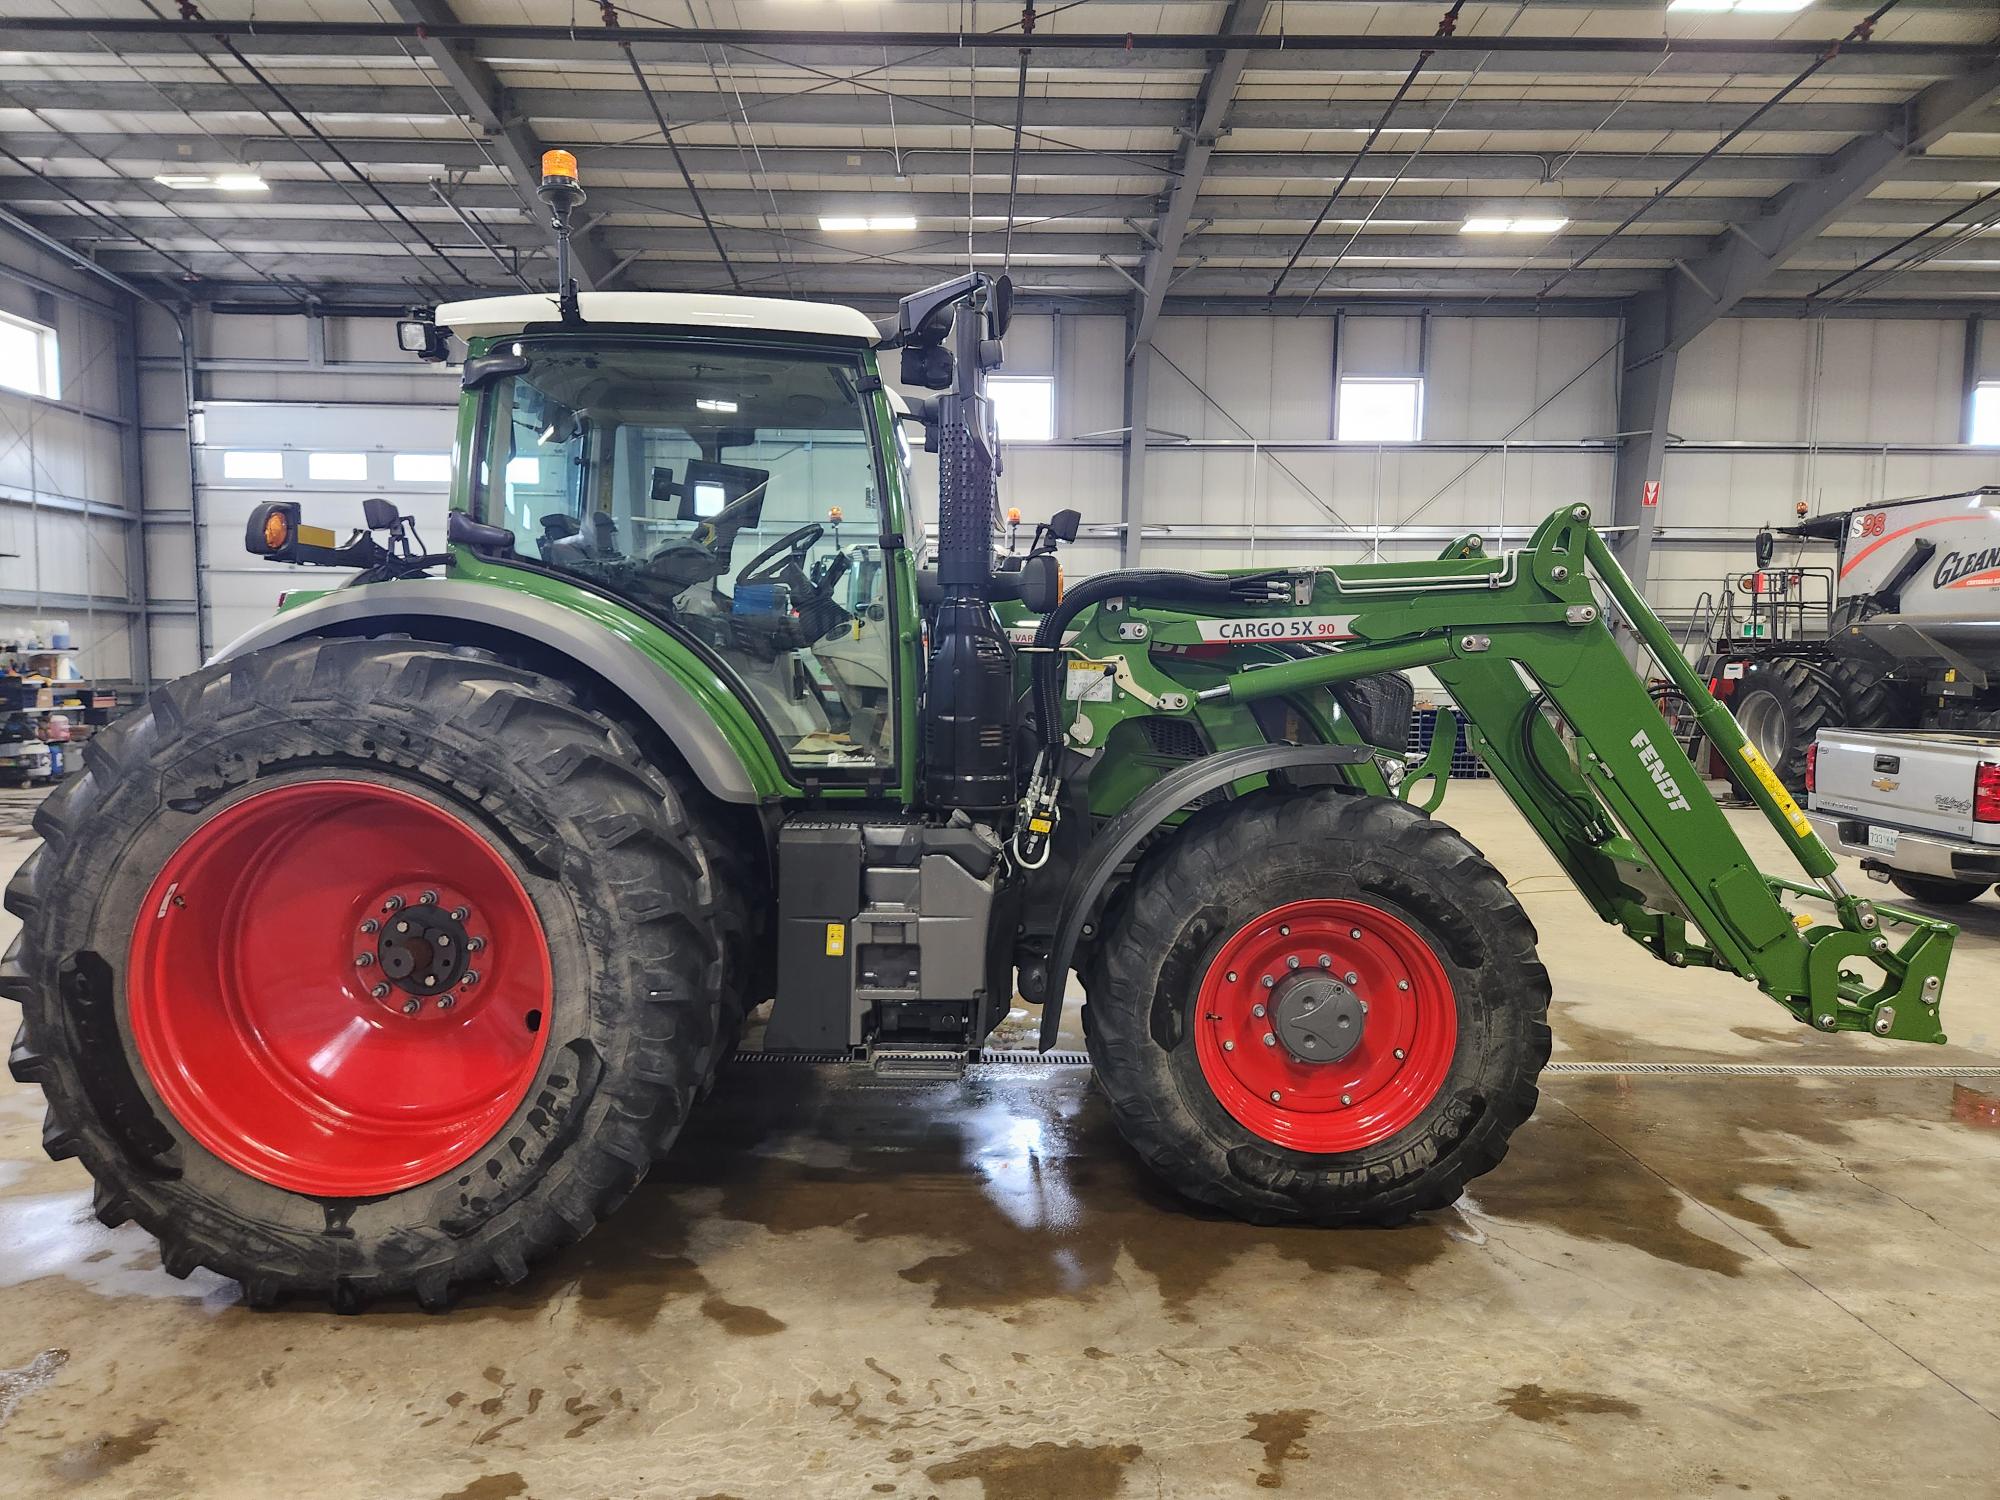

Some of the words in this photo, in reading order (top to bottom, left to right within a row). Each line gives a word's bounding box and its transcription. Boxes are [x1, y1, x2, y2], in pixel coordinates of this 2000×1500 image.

[1850, 513, 1886, 538] S98
[1219, 622, 1285, 638] CARGO
[1290, 621, 1313, 636] 5X
[1318, 623, 1335, 635] 90
[1630, 728, 1692, 811] FENDT
